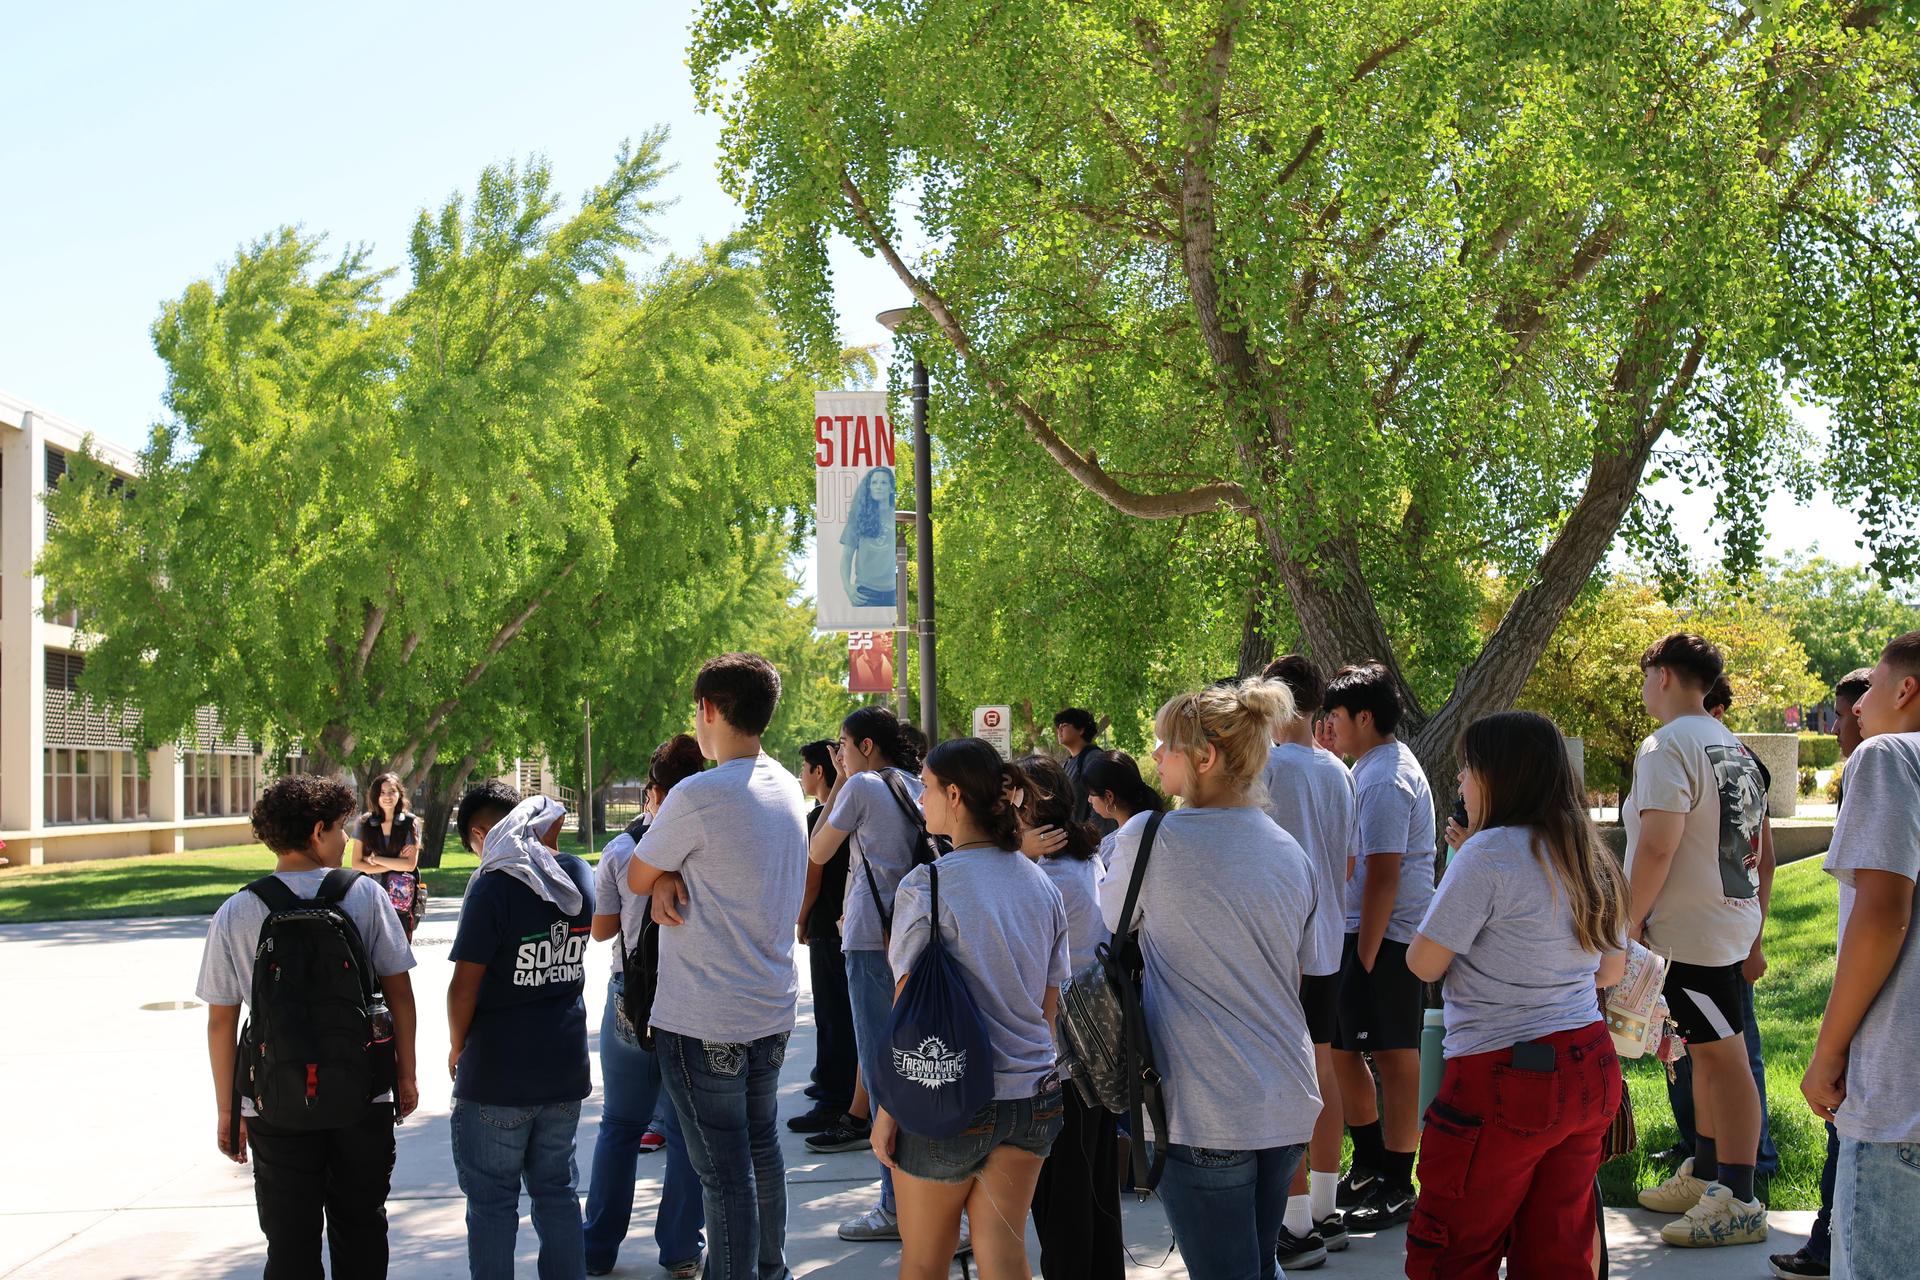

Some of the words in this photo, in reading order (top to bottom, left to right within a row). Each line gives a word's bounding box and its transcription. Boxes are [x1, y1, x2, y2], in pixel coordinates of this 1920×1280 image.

[815, 415, 896, 467] STAN
[513, 963, 583, 987] CAMPEONE
[902, 1053, 934, 1073] FRESNO
